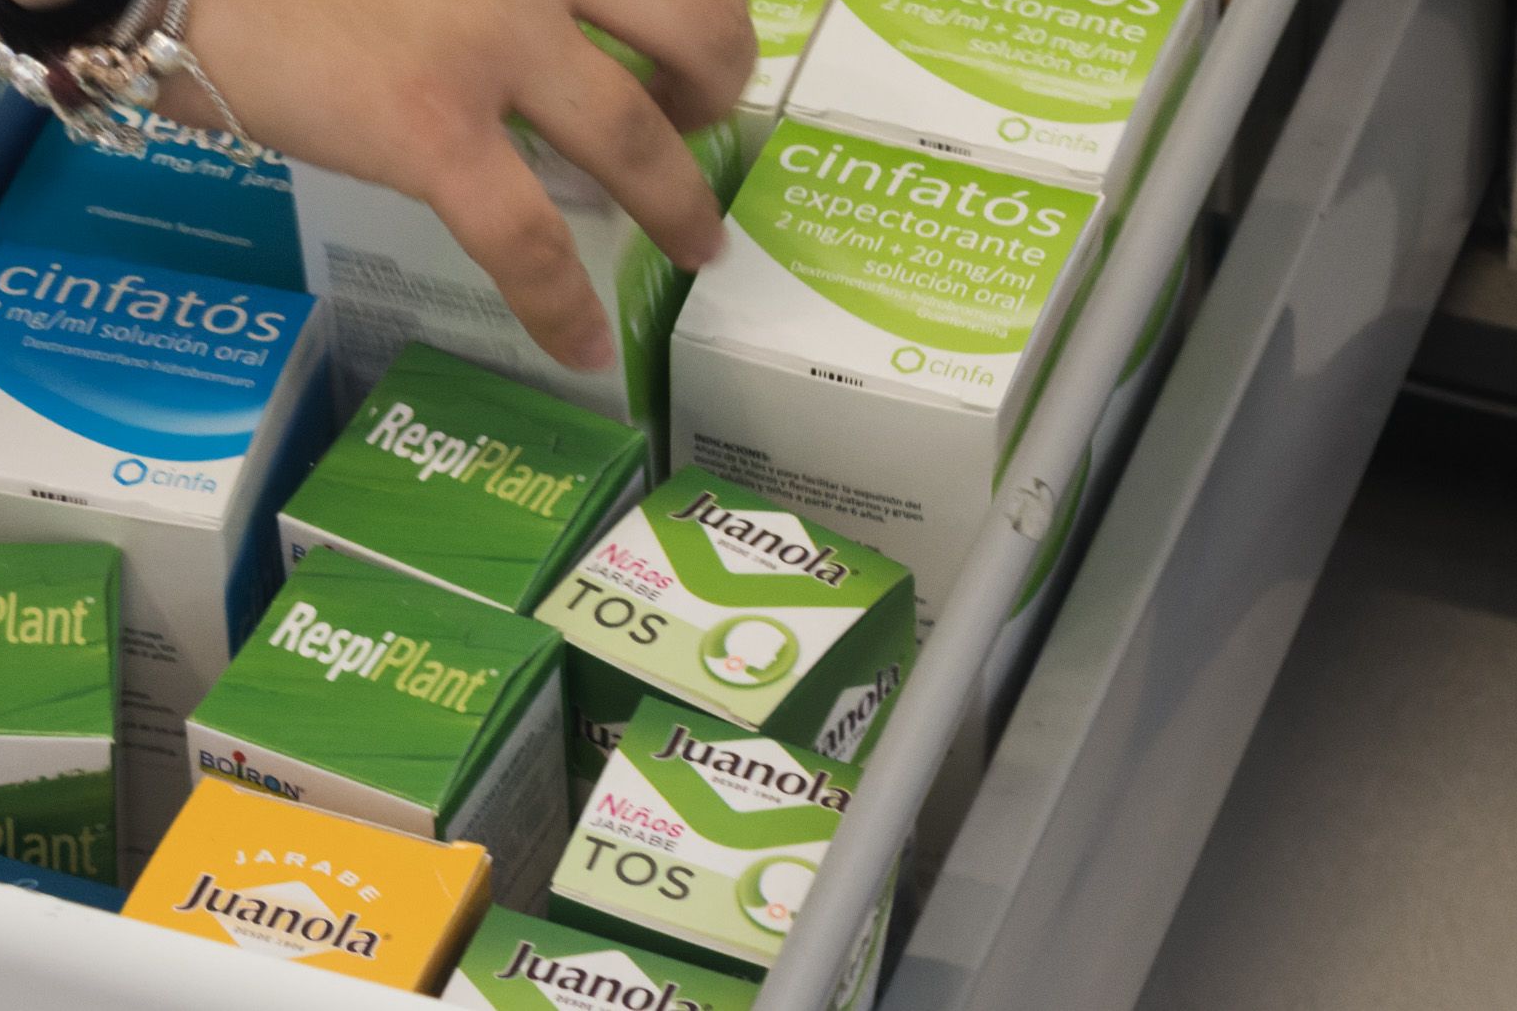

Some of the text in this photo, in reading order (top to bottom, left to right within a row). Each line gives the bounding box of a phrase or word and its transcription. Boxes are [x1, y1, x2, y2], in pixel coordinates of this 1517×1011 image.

[903, 0, 989, 33] mg/ml
[1011, 22, 1048, 46] 20
[1049, 32, 1137, 66] mg/ml
[969, 35, 1074, 74] solución
[1077, 55, 1128, 83] oral
[1034, 125, 1101, 155] cinfa
[778, 141, 1066, 239] cinfatós
[775, 212, 793, 230] 2
[797, 219, 884, 254] mg/ml
[909, 244, 944, 268] 20
[948, 257, 1036, 292] mg/ml
[784, 181, 1047, 267] expectorante
[863, 259, 1026, 313] solución oral
[4, 304, 96, 337] mg/ml
[99, 320, 208, 359] solución
[213, 342, 269, 368] oral
[929, 355, 996, 389] cinfa
[151, 469, 217, 496] cinfa
[366, 401, 574, 518] RespiPlant
[596, 543, 675, 590] Niños
[669, 491, 850, 588] Juanola
[565, 578, 669, 646] TOS
[585, 562, 662, 603] JARABE
[268, 601, 488, 714] RespiPlant
[199, 750, 301, 801] BOIRON
[652, 724, 853, 815] Juanola
[589, 817, 679, 853] JARABE
[596, 792, 685, 839] Niños
[234, 848, 382, 903] JARABE
[585, 835, 696, 901] TOS
[174, 874, 381, 960] Juanola
